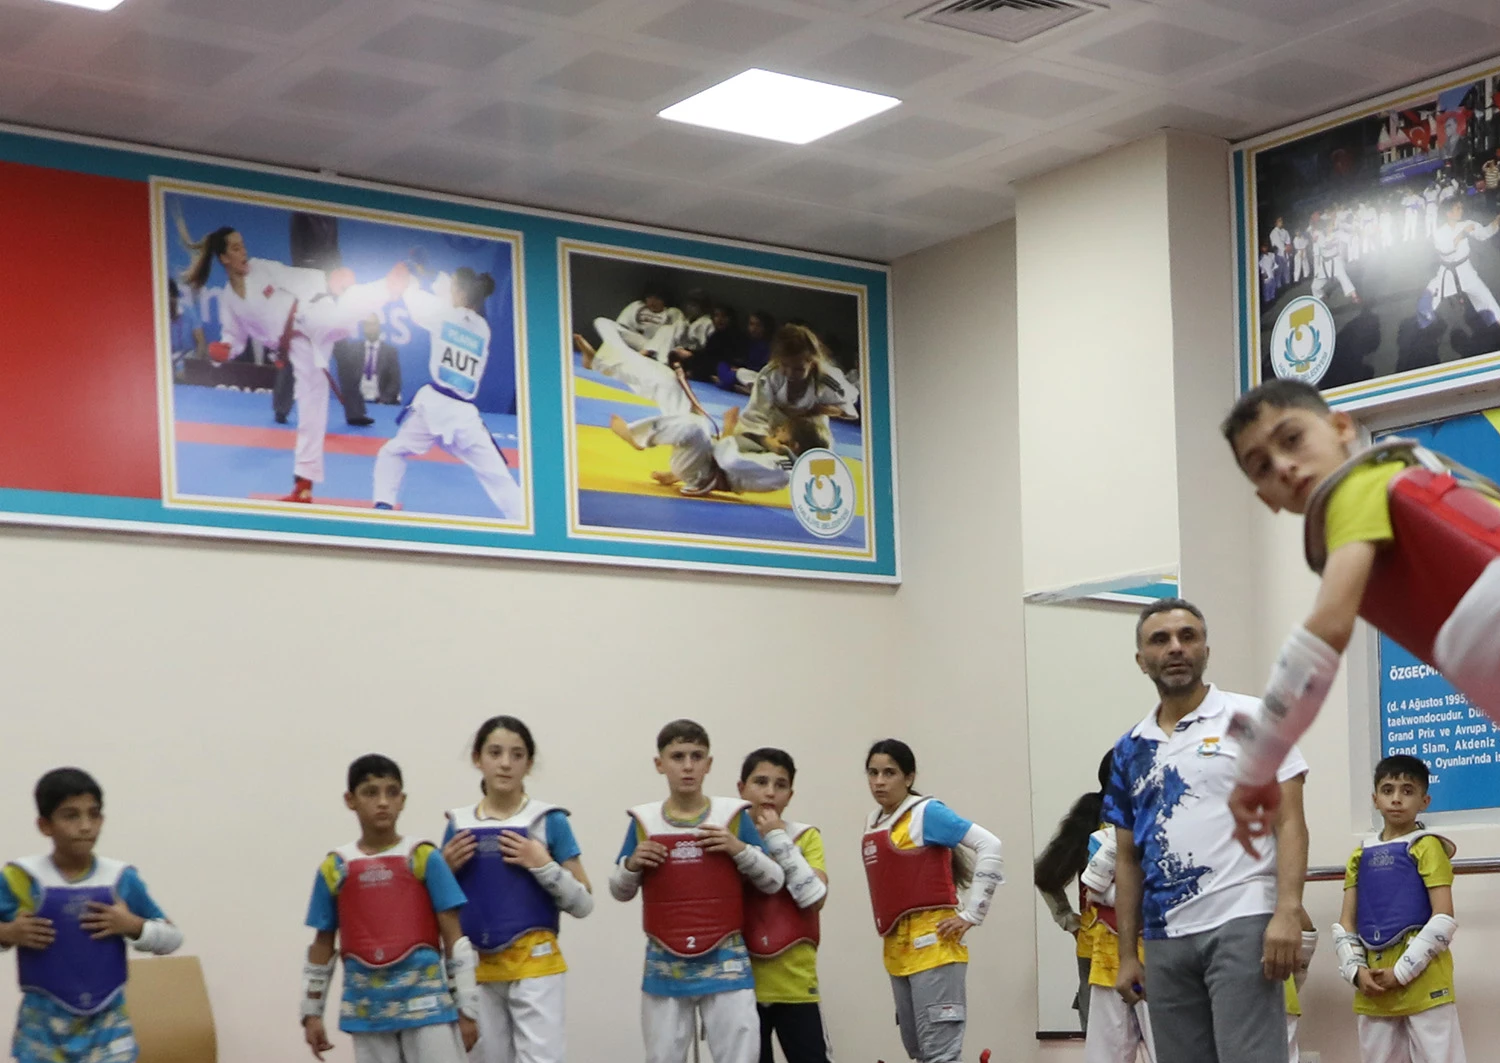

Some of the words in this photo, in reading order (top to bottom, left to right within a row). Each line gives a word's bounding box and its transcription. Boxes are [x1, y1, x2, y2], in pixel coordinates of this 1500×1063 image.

[441, 346, 479, 377] AUT
[1389, 664, 1443, 681] ÖZGEÇM
[1400, 701, 1406, 710] 4
[1408, 697, 1444, 712] Ağustos
[1387, 710, 1464, 728] taekwondocudur.
[1387, 728, 1415, 743] Grand
[1418, 727, 1436, 740] Prix
[1440, 727, 1451, 738] ve
[1454, 723, 1487, 737] Avrupa
[1388, 744, 1418, 757] Grand
[1422, 742, 1450, 754] Slam,
[1454, 736, 1496, 751] Akdeniz
[685, 935, 697, 949] 2
